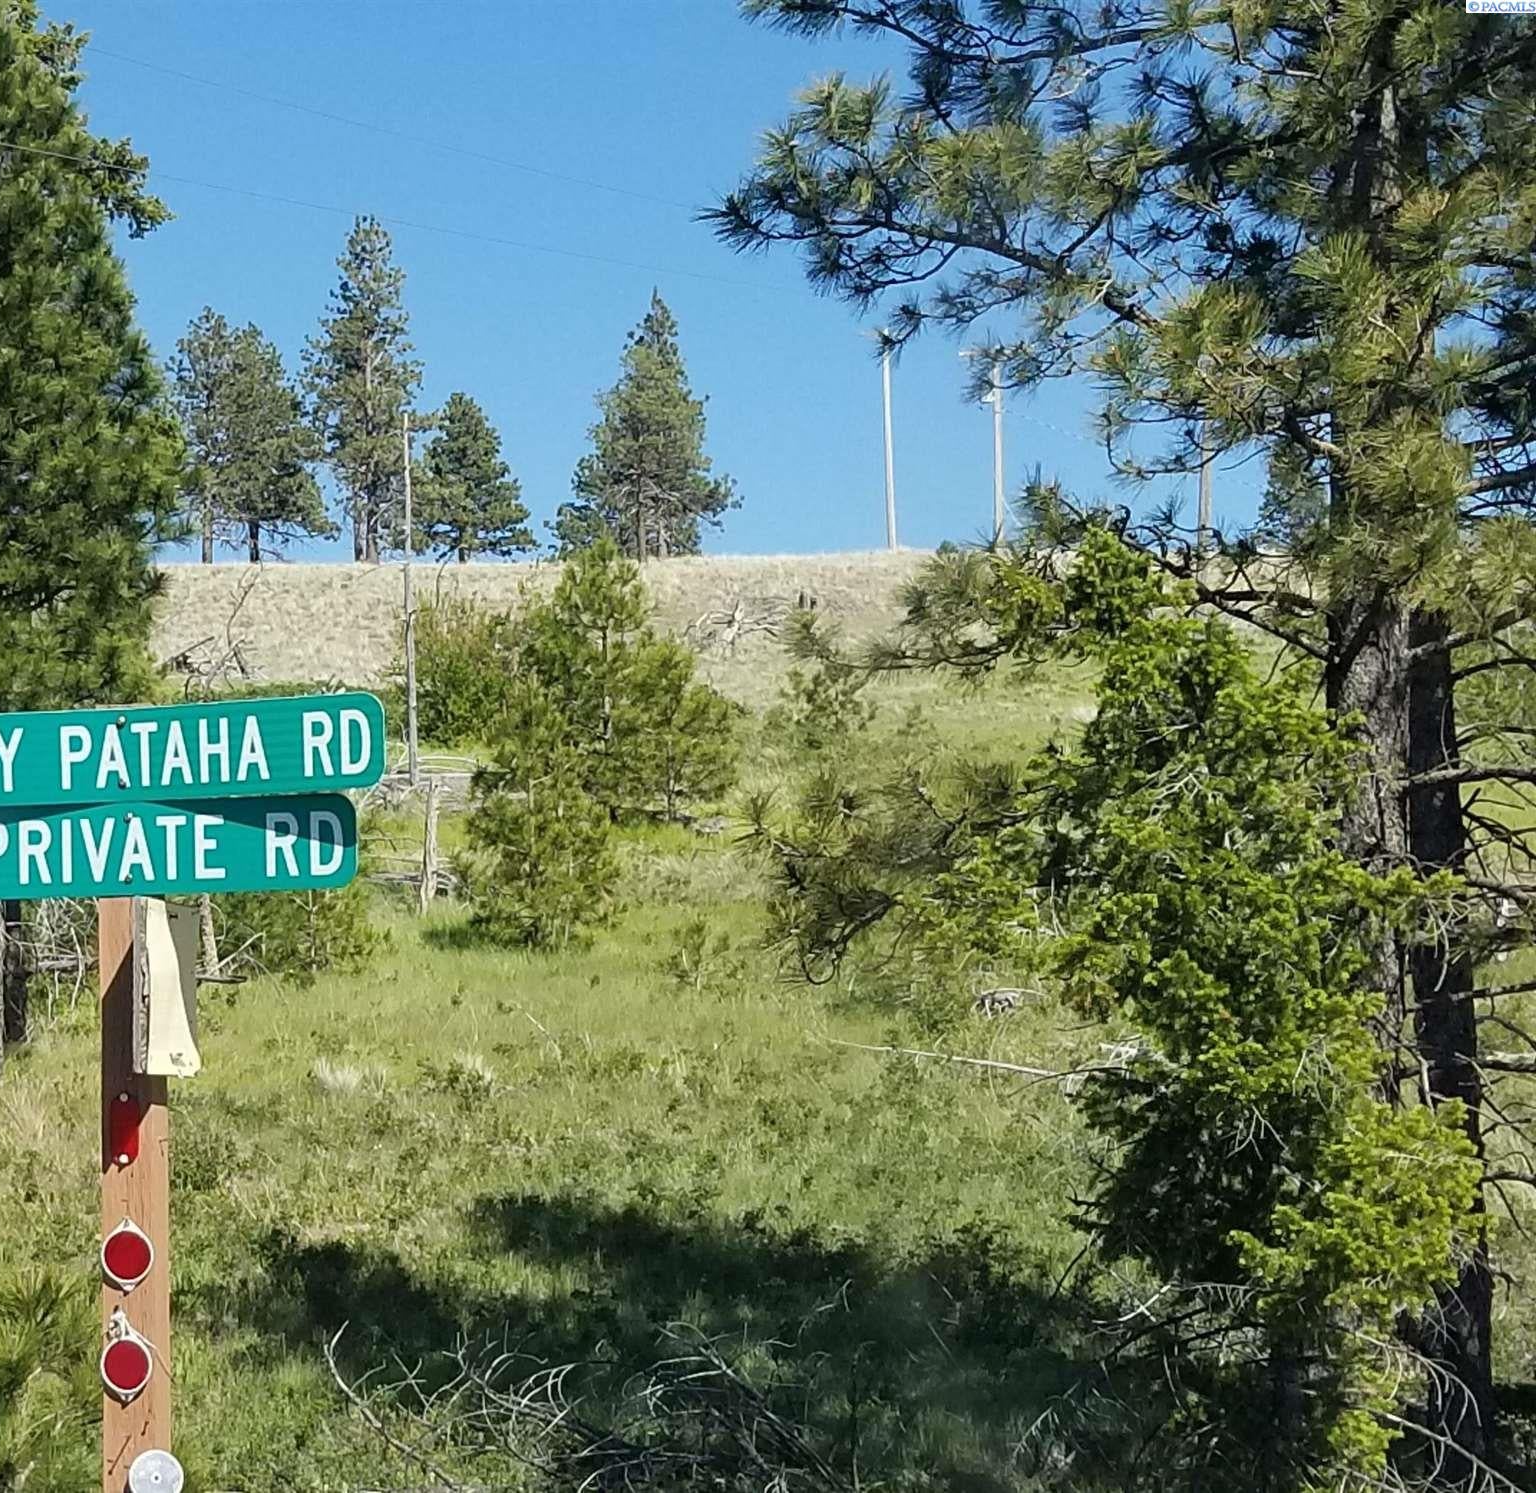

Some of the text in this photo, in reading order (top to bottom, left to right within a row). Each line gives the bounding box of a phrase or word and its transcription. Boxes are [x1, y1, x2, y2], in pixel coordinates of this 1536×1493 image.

[59, 714, 271, 790] PATAHA
[301, 709, 372, 777] RD
[264, 810, 344, 877] RD
